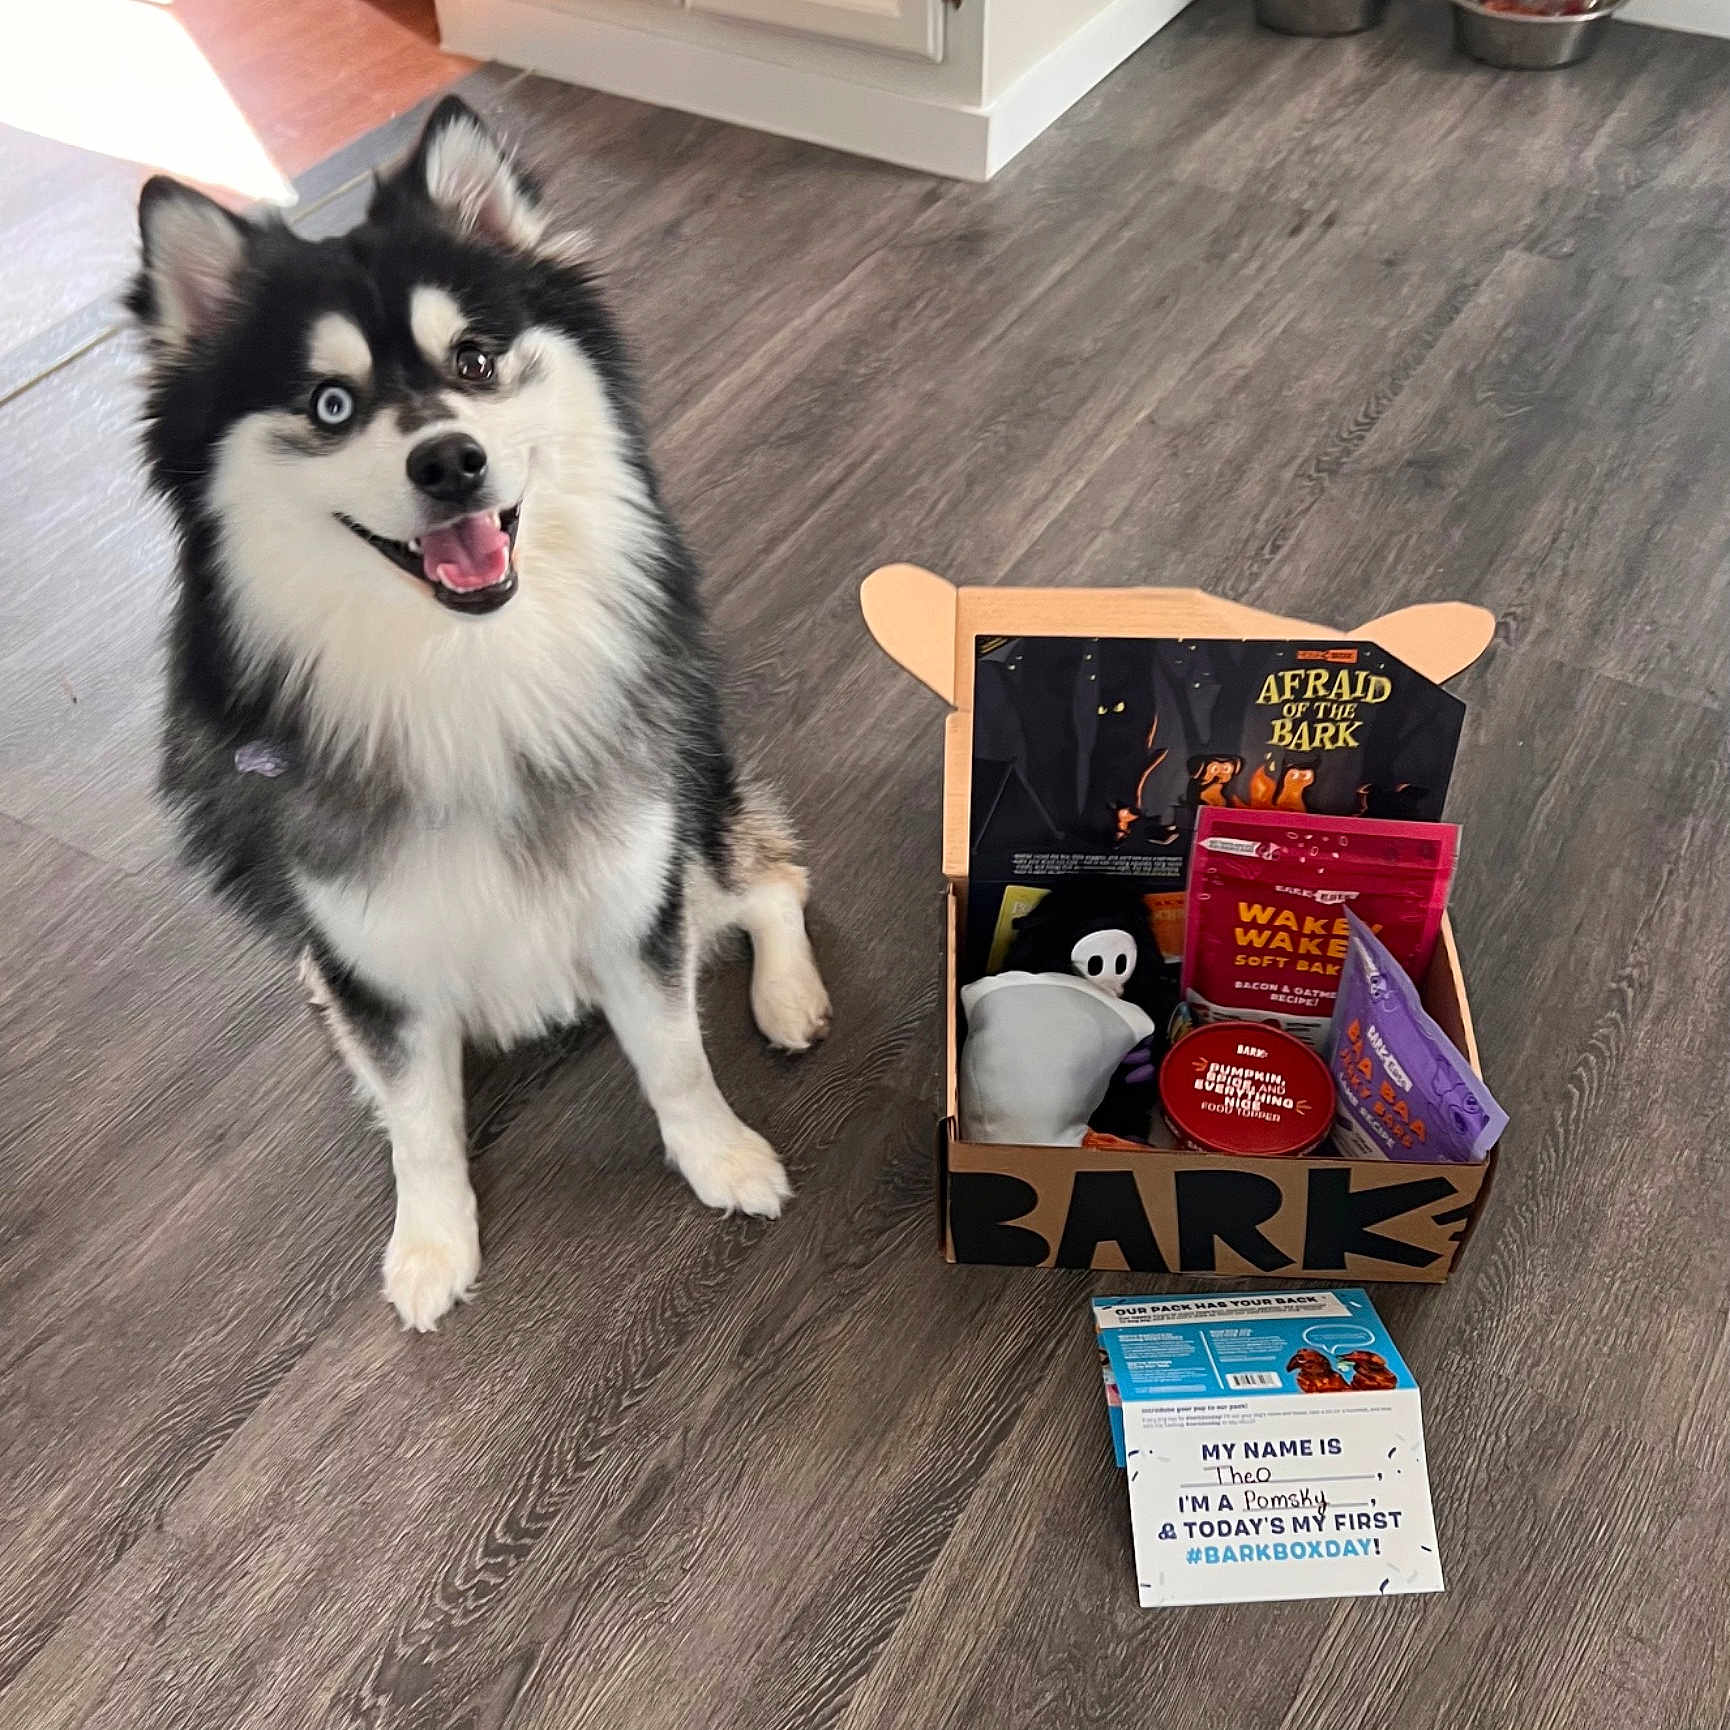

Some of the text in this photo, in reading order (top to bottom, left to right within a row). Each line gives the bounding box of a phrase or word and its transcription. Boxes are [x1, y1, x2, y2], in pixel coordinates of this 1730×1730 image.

[1256, 669, 1392, 704] AFRAID
[1282, 702, 1358, 720] OF THE
[1266, 718, 1363, 751] BARK
[1238, 902, 1383, 936] WAKE
[1234, 928, 1350, 958] WAKE
[1235, 954, 1341, 975] SOFT BAK
[1234, 981, 1279, 992] BACON
[1294, 987, 1337, 999] OATME
[1270, 993, 1320, 1007] RECIPE!
[1237, 1044, 1268, 1058] BARK
[1209, 1062, 1286, 1086] PUMPKIN,
[1194, 1078, 1294, 1109] EVERYTHING
[1259, 1083, 1286, 1095] AND
[1224, 1096, 1261, 1111] NICE
[948, 1168, 1458, 1272] BARK
[1115, 1306, 1147, 1316] OUR
[1150, 1303, 1193, 1313] PACK
[1194, 1300, 1228, 1310] HAS
[1229, 1298, 1273, 1308] YOUR
[1274, 1296, 1318, 1305] BACK
[1202, 1438, 1342, 1461] MY NAME IS
[1178, 1494, 1234, 1513] I'M A
[1158, 1511, 1403, 1540] & TODAY'S MY FIRST
[1186, 1537, 1381, 1564] #BARKBOXDAY!
